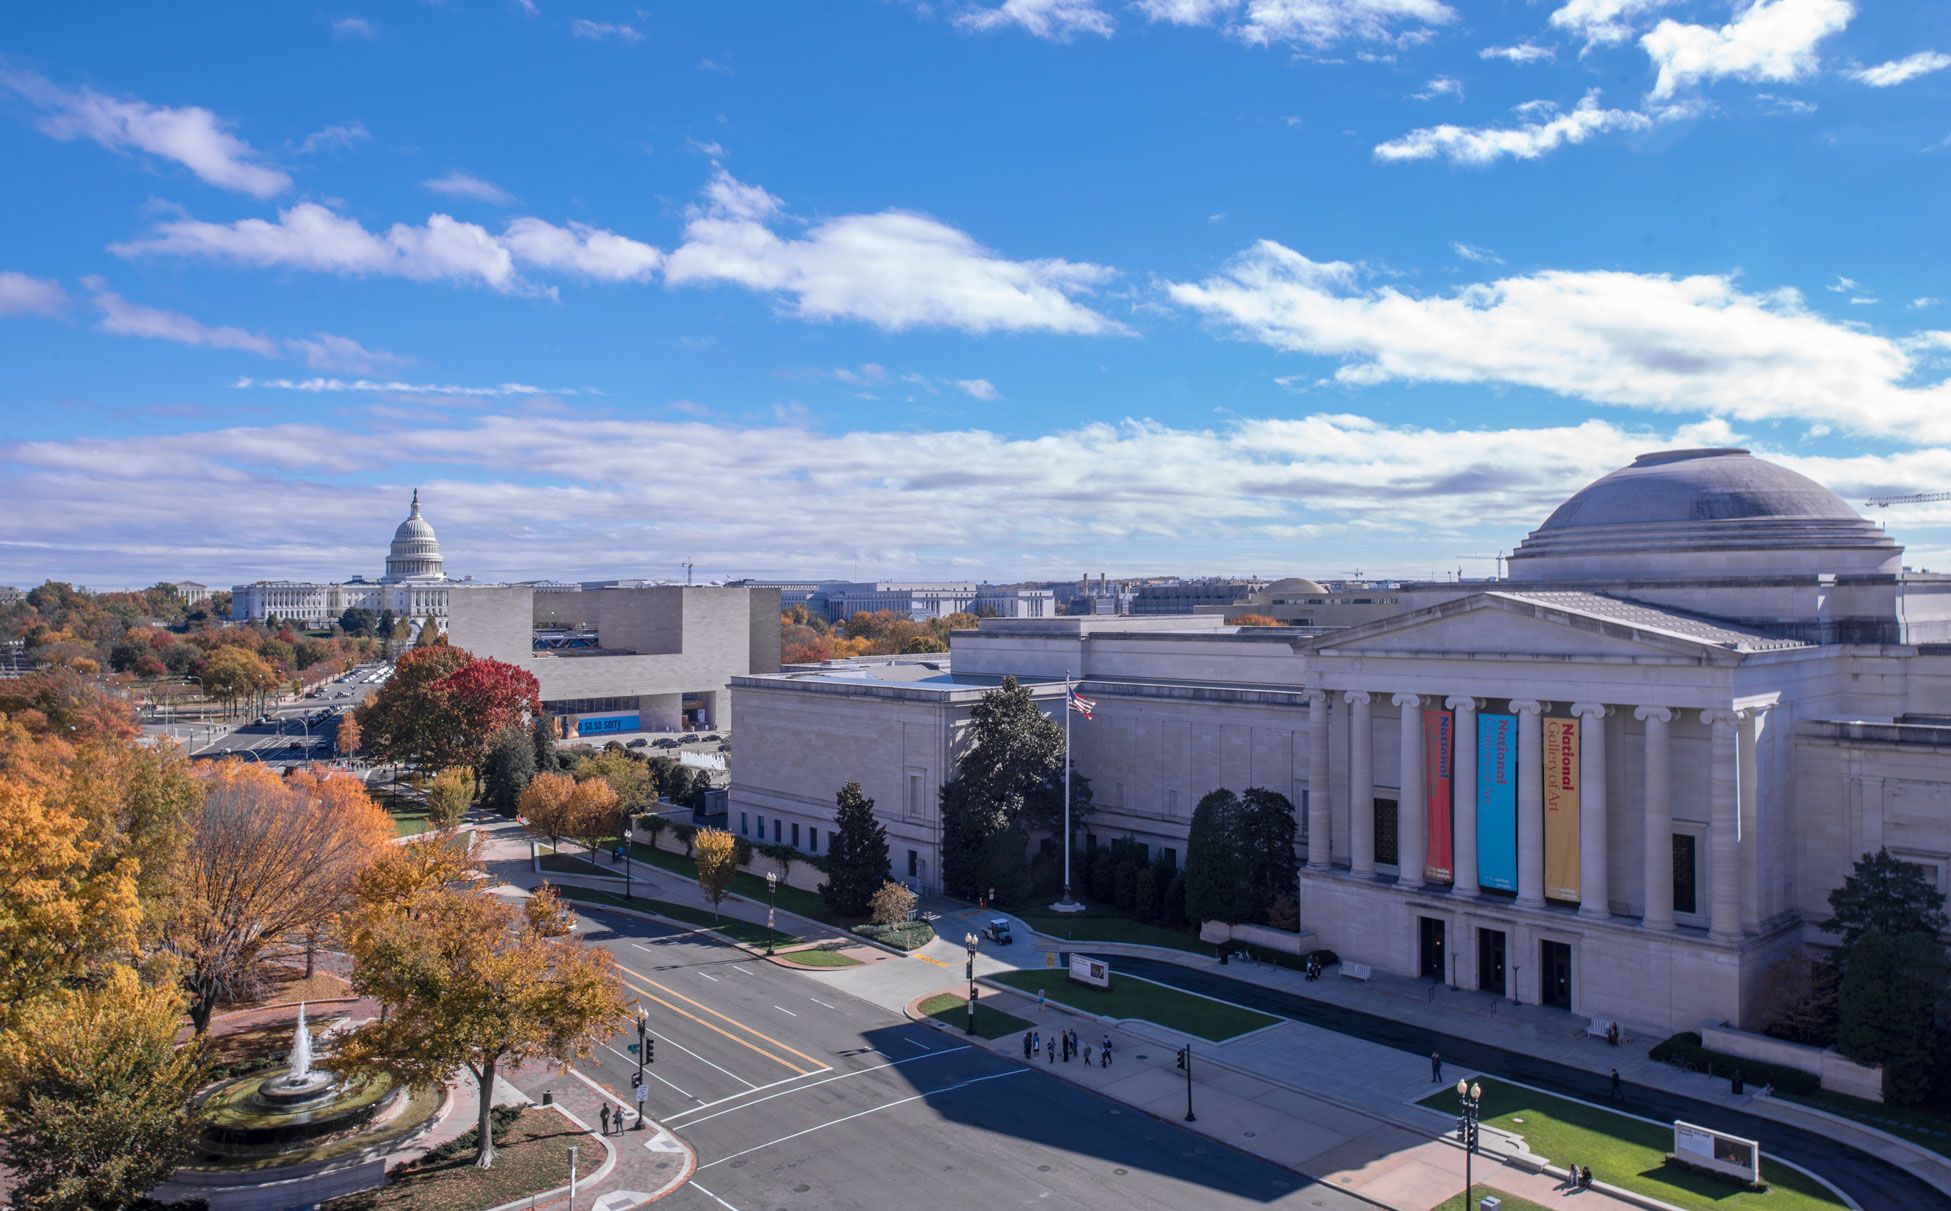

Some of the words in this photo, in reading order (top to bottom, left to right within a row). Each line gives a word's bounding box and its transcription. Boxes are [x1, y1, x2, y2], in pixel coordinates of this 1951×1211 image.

[604, 719, 622, 733] sorry
[1440, 716, 1449, 778] National
[1546, 721, 1560, 771] Gallery
[1497, 719, 1509, 784] National
[1562, 723, 1574, 791] National
[1548, 774, 1560, 791] of
[1548, 791, 1560, 811] Art
